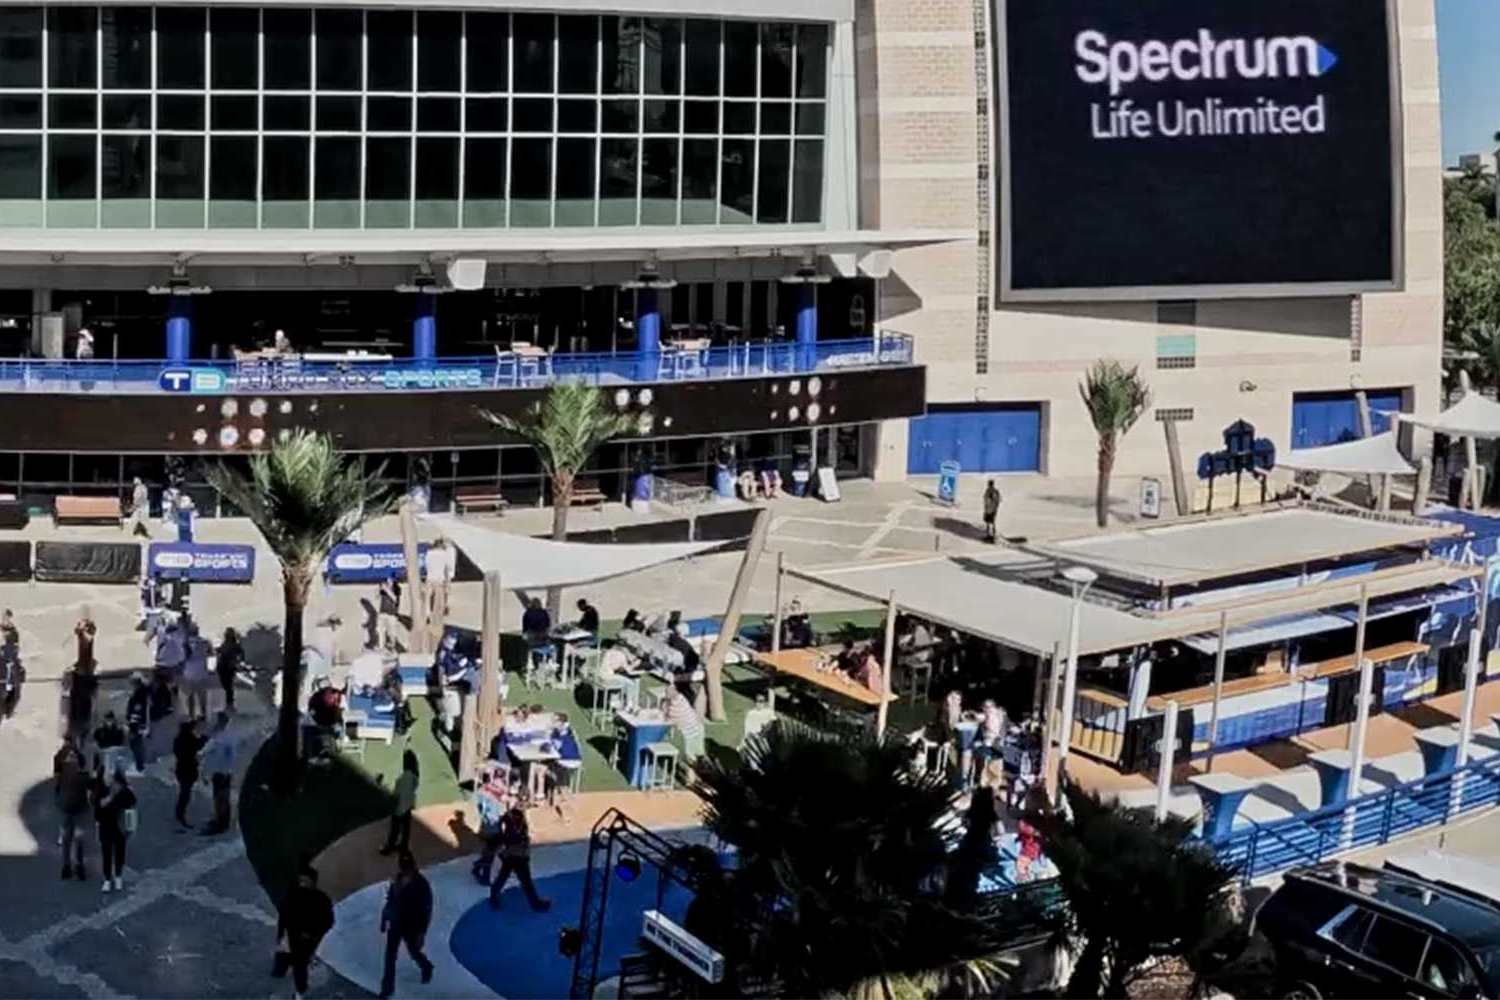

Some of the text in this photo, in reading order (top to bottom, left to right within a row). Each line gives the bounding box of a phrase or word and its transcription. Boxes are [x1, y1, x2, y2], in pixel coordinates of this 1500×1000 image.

[1075, 28, 1322, 96] Spectrum
[1091, 94, 1326, 139] Life Unlimited
[384, 369, 483, 388] SPORTS
